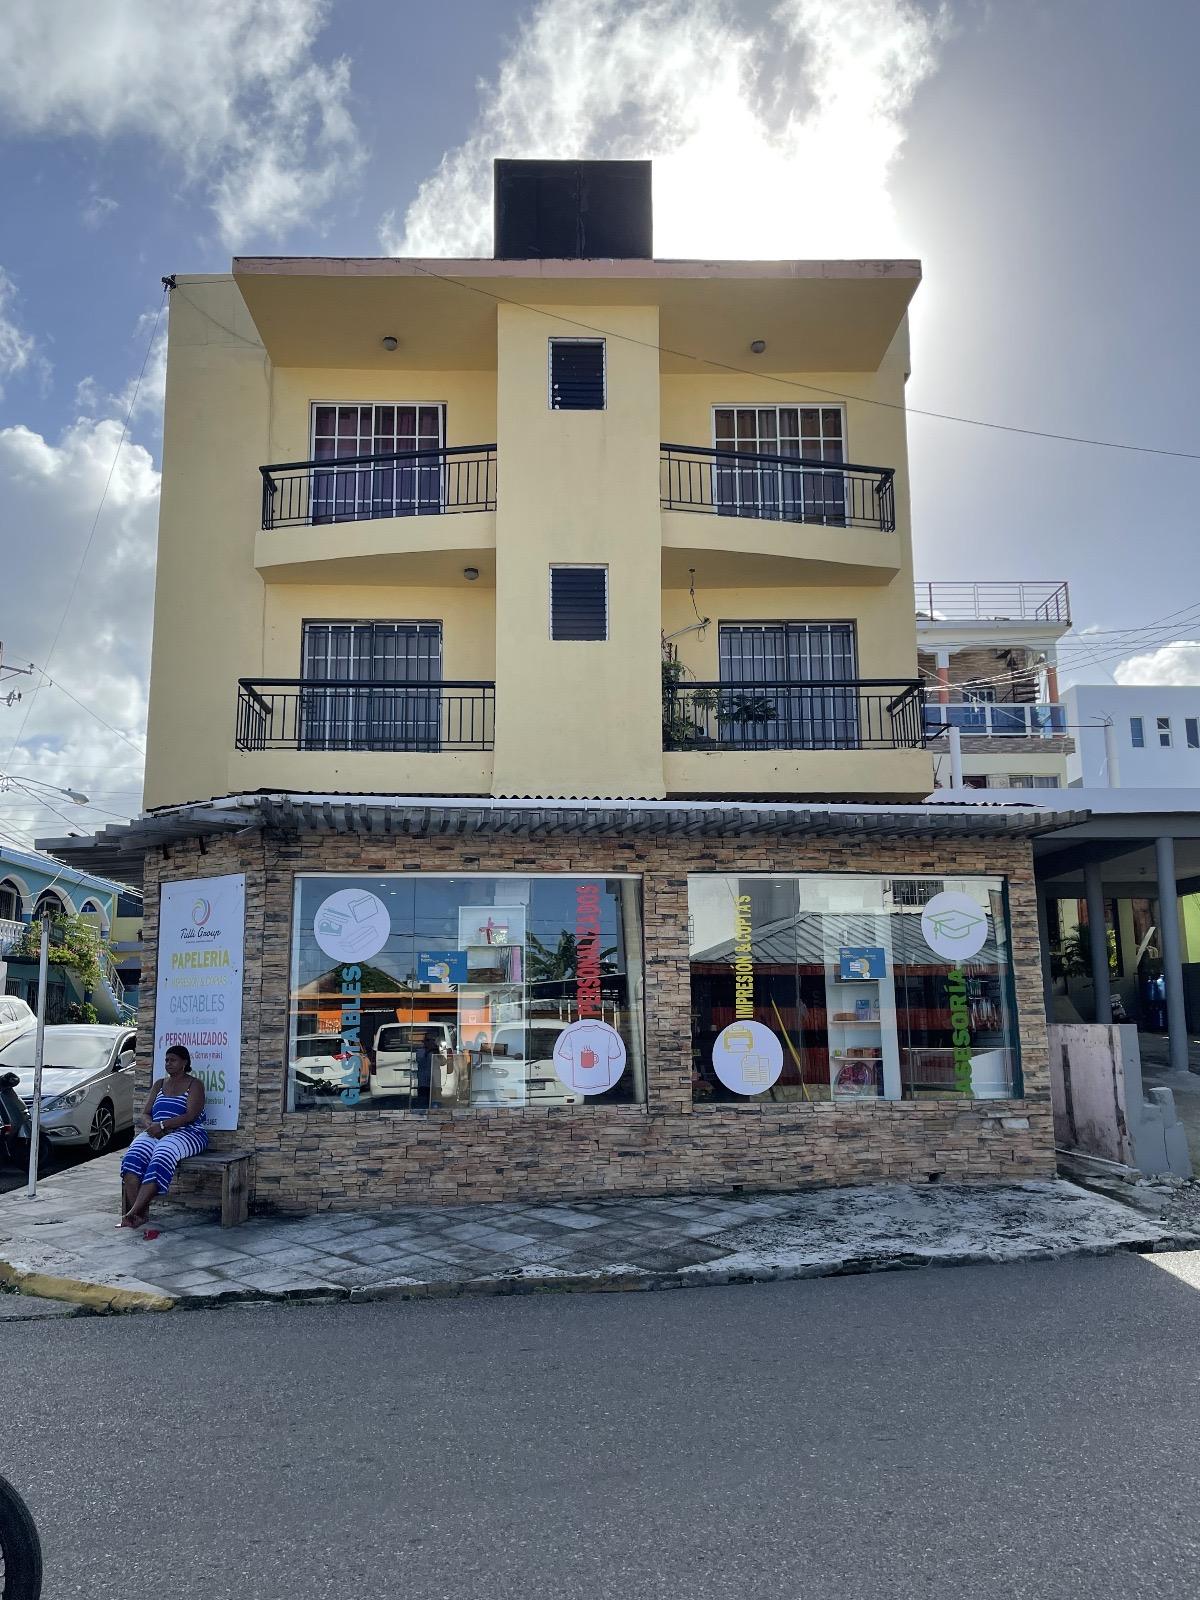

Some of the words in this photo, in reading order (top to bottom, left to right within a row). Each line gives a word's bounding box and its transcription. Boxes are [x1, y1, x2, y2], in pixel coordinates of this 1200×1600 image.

[198, 926, 221, 939] Group
[735, 896, 752, 942] COPIAS
[171, 946, 230, 969] PAPELERÍA
[576, 884, 601, 1016] PERSONALIZADOS
[170, 994, 225, 1013] GASTABLES
[731, 956, 753, 1018] IMPRESIÓN
[165, 1031, 228, 1046] PERSONALIZADOS
[340, 966, 362, 1105] GASTABLES
[944, 968, 971, 1093] ASESORÍA
